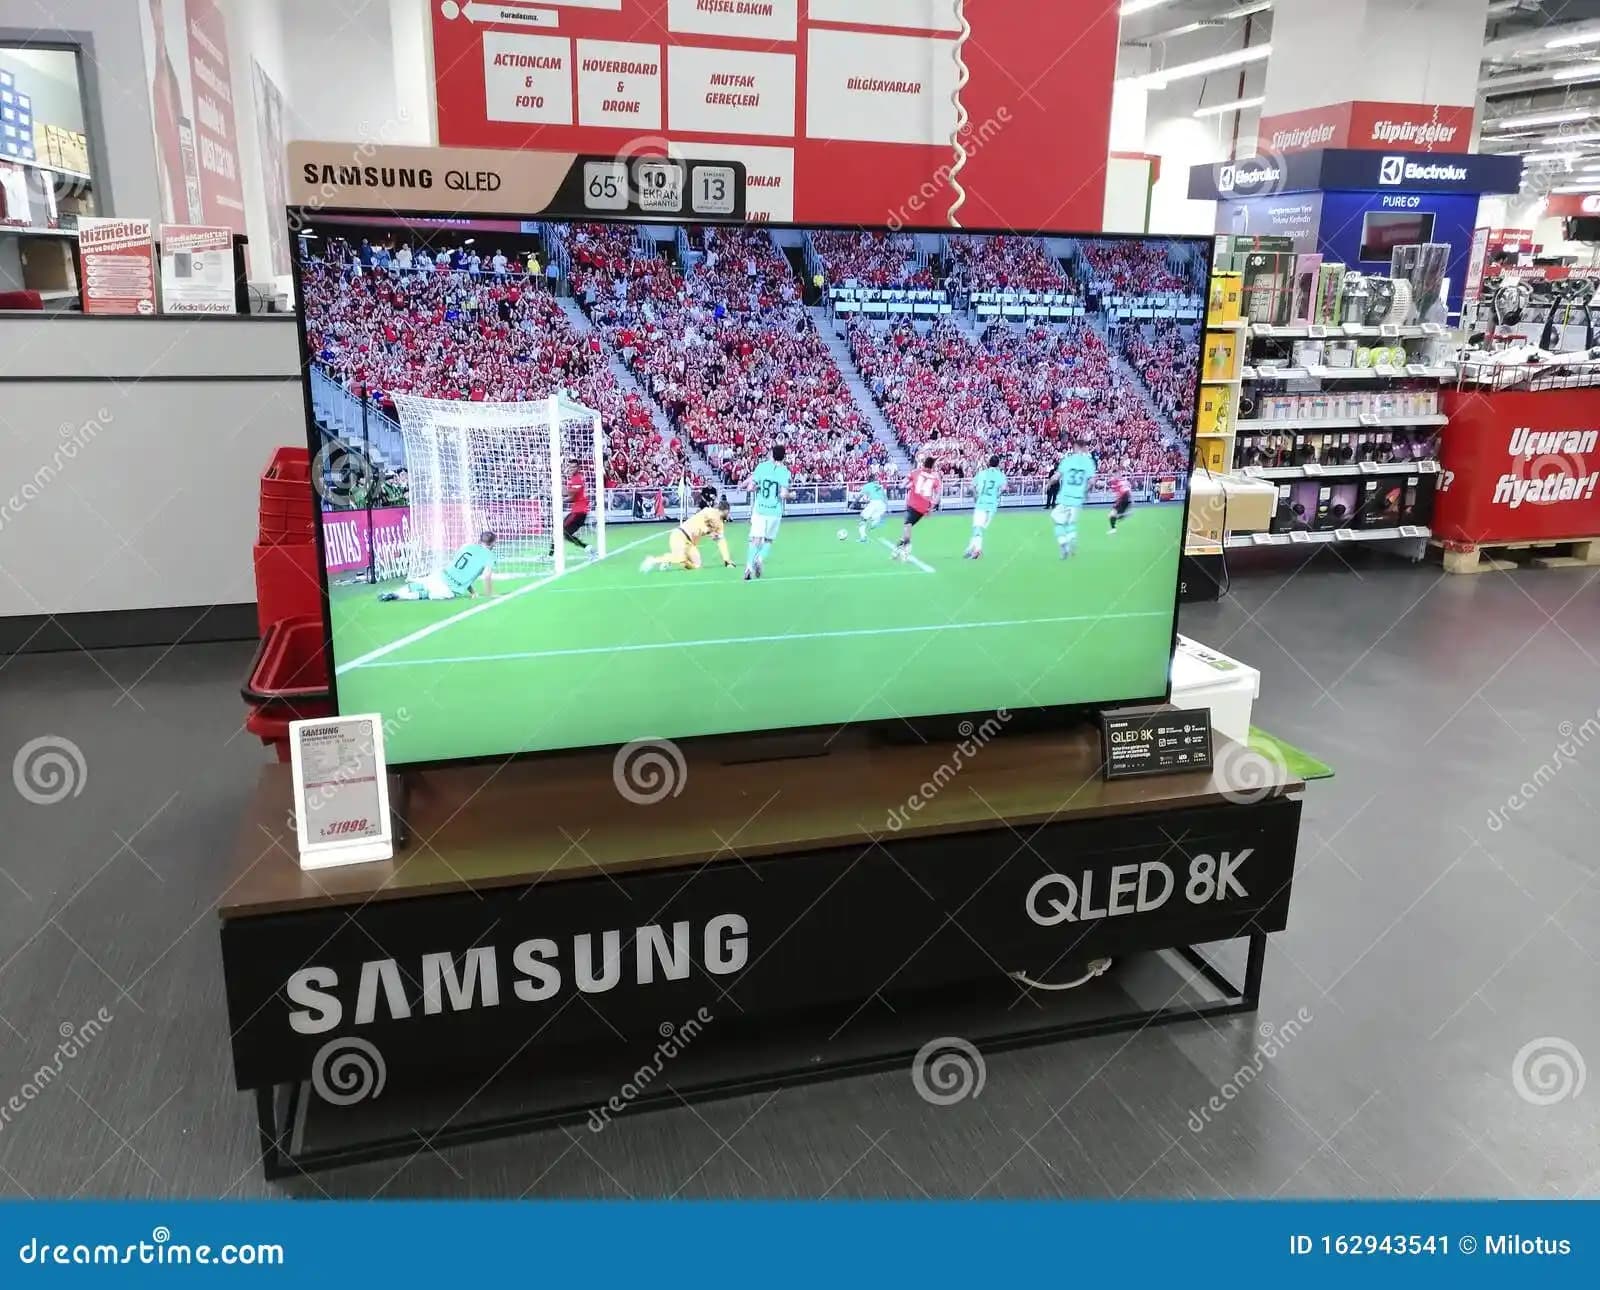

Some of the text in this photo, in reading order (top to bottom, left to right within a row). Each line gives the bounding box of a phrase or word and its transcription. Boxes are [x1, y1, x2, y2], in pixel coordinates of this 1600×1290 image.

[736, 2, 773, 16] BAKIM
[493, 53, 562, 71] ACTIONCAM
[582, 58, 658, 77] HOVERBOARD
[524, 75, 533, 88] &
[617, 81, 625, 93] &
[710, 73, 755, 88] MUTFAK
[847, 77, 921, 95] BİLGİSAYARLAR
[515, 95, 544, 109] FOTO
[602, 100, 640, 114] DRONE
[705, 90, 760, 108] GEREÇLERİ
[1271, 122, 1336, 151] Süpürgeler
[1371, 120, 1457, 145] Süpürgeler
[303, 163, 501, 192] SAMSUNG QLED
[644, 171, 666, 189] 10
[1235, 165, 1280, 184] Electrolux
[1404, 162, 1468, 181] Electrolux
[643, 189, 678, 201] EKRAN
[702, 178, 726, 201] 13
[1382, 195, 1406, 208] PURE
[80, 223, 149, 244] Hizmetler
[1508, 427, 1598, 458] Uçuran
[1067, 468, 1085, 486] 33
[982, 480, 995, 496] 12
[1492, 471, 1600, 508] fiyatlar!
[323, 520, 361, 567] HIVAS
[454, 551, 473, 569] 6
[302, 727, 339, 737] SAMSUNG
[1111, 730, 1139, 744] QLED
[1140, 728, 1154, 741] 8K
[1025, 849, 1254, 926] QLED 8K
[286, 913, 750, 1035] SAMSUNG
